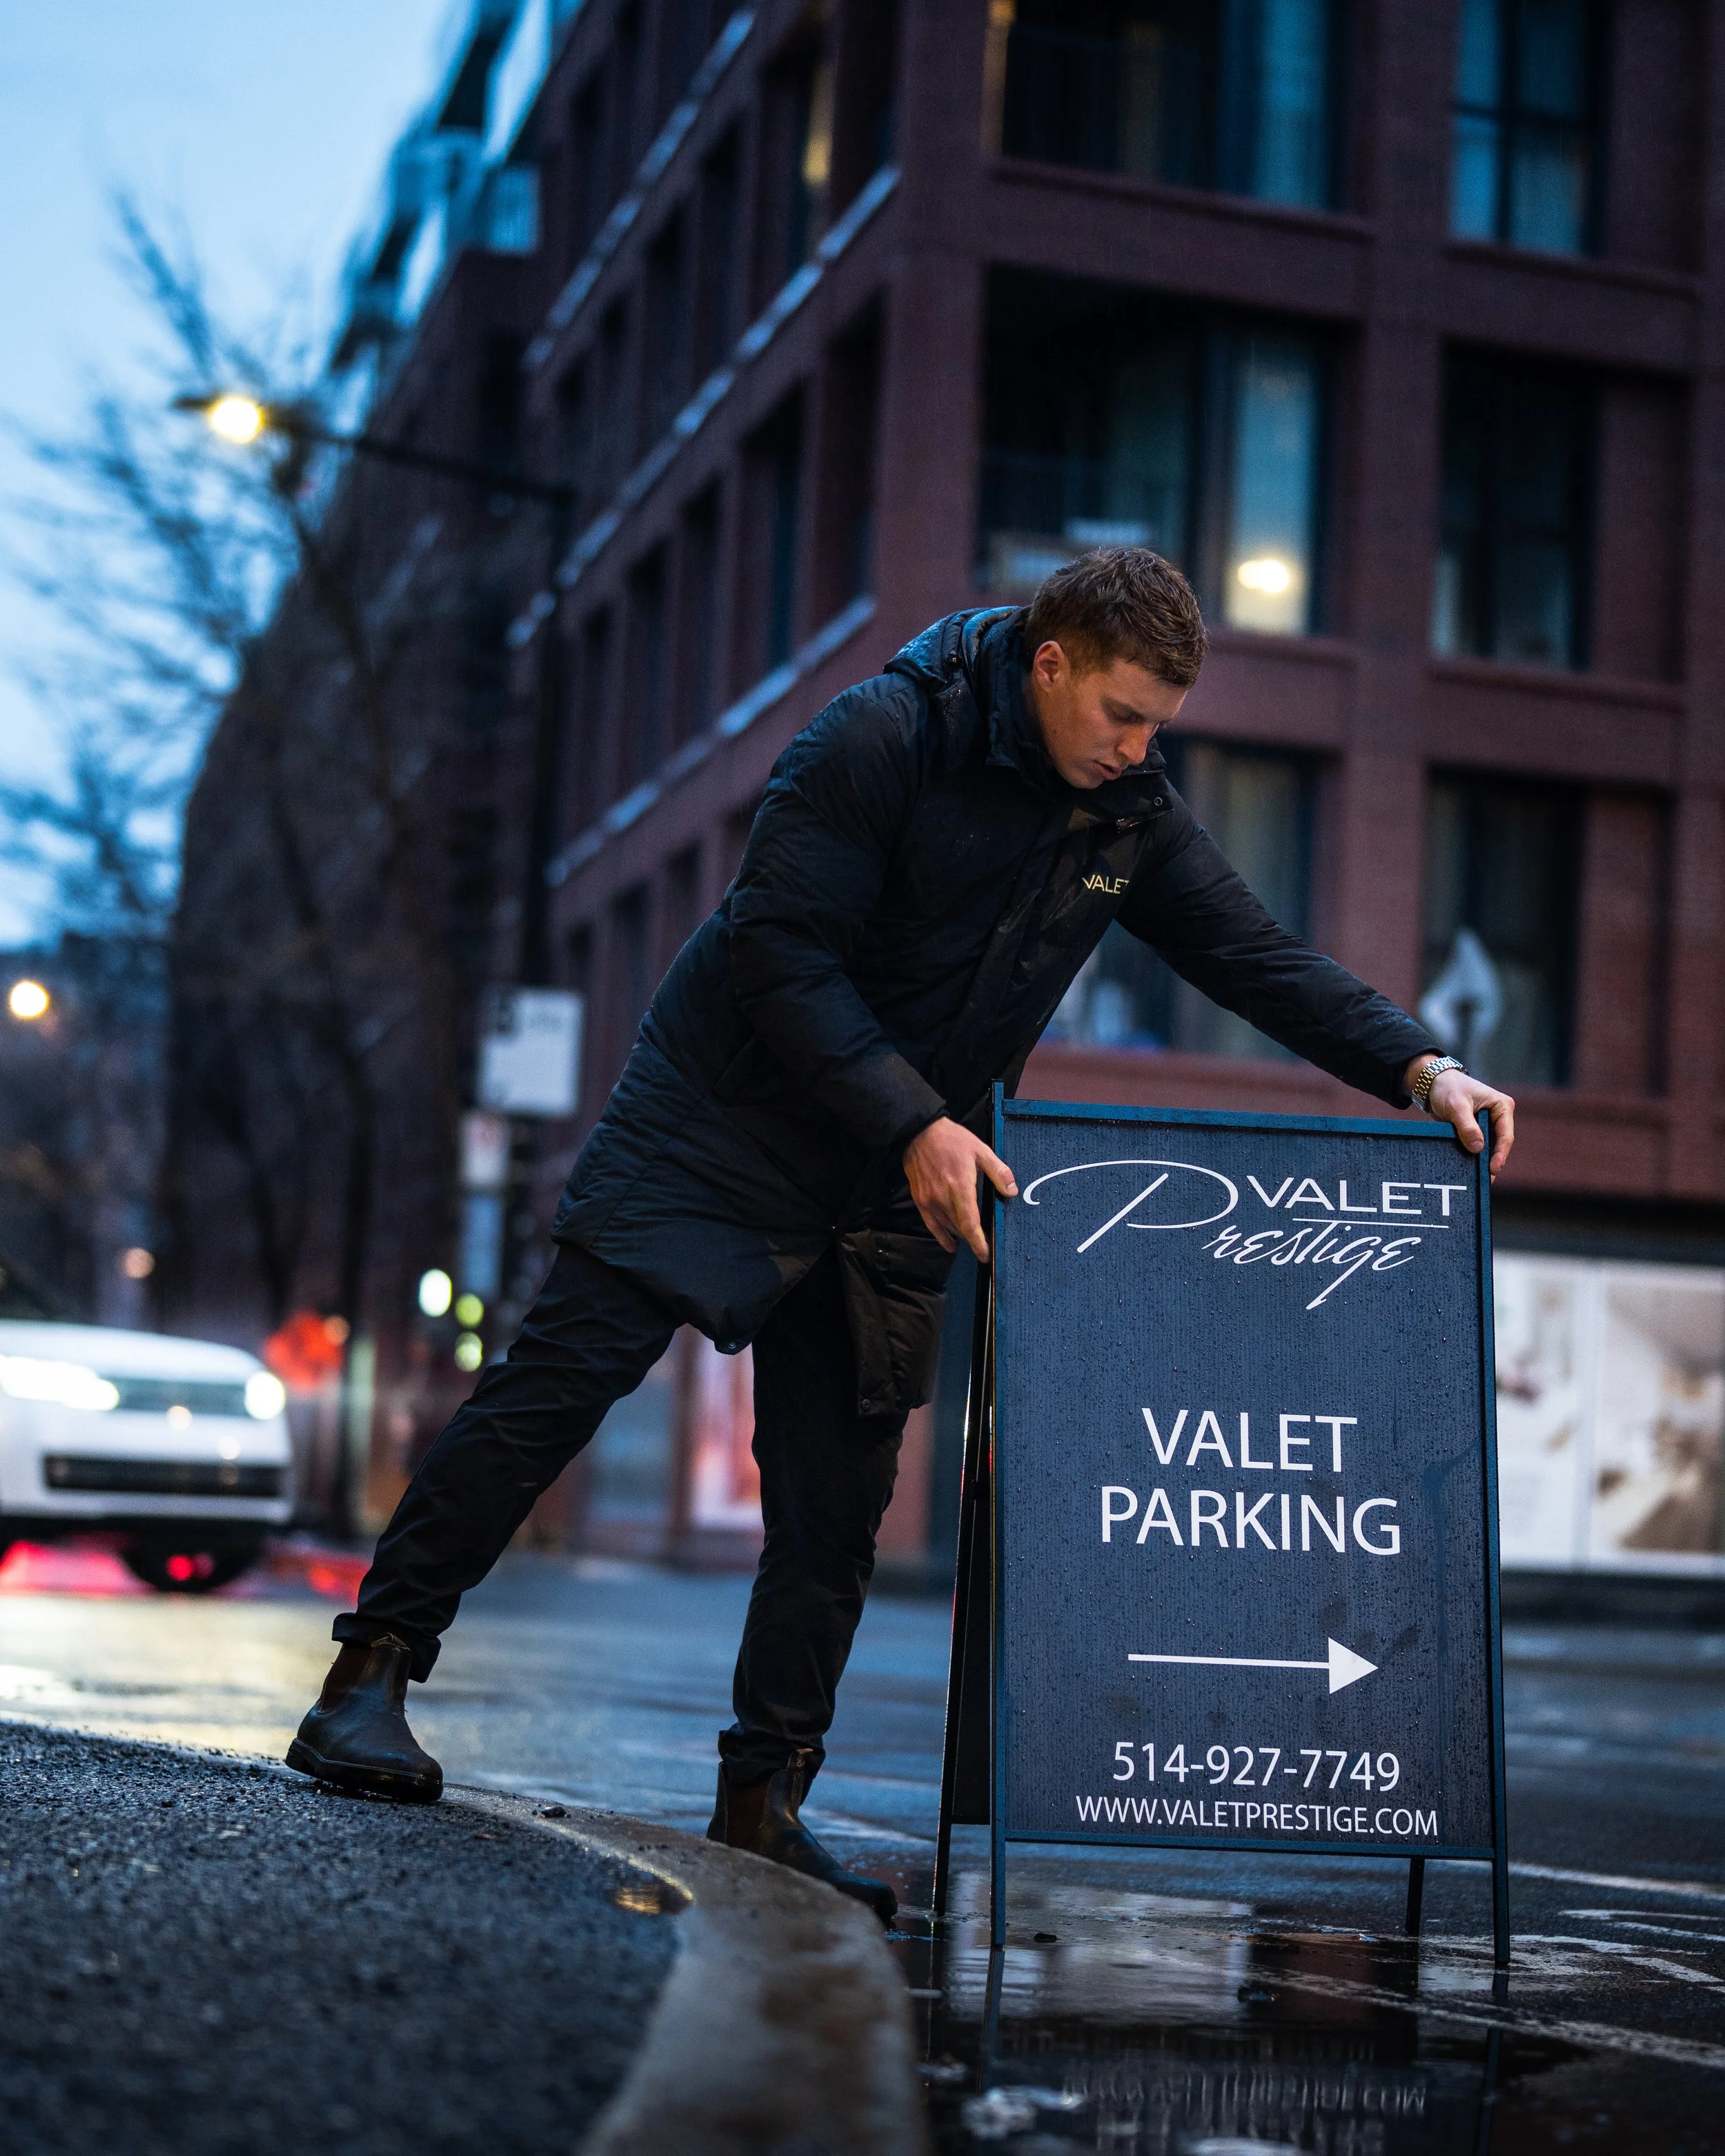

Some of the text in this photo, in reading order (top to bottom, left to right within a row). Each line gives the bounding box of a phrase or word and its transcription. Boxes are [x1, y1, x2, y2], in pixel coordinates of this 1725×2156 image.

[1246, 1175, 1467, 1216] VALET
[1141, 1407, 1358, 1472] VALET
[1101, 1485, 1401, 1556] PARKING
[1113, 1741, 1399, 1792] 514-927-7749
[1076, 1795, 1438, 1837] WWW.VALETPRESTIGE.COM
